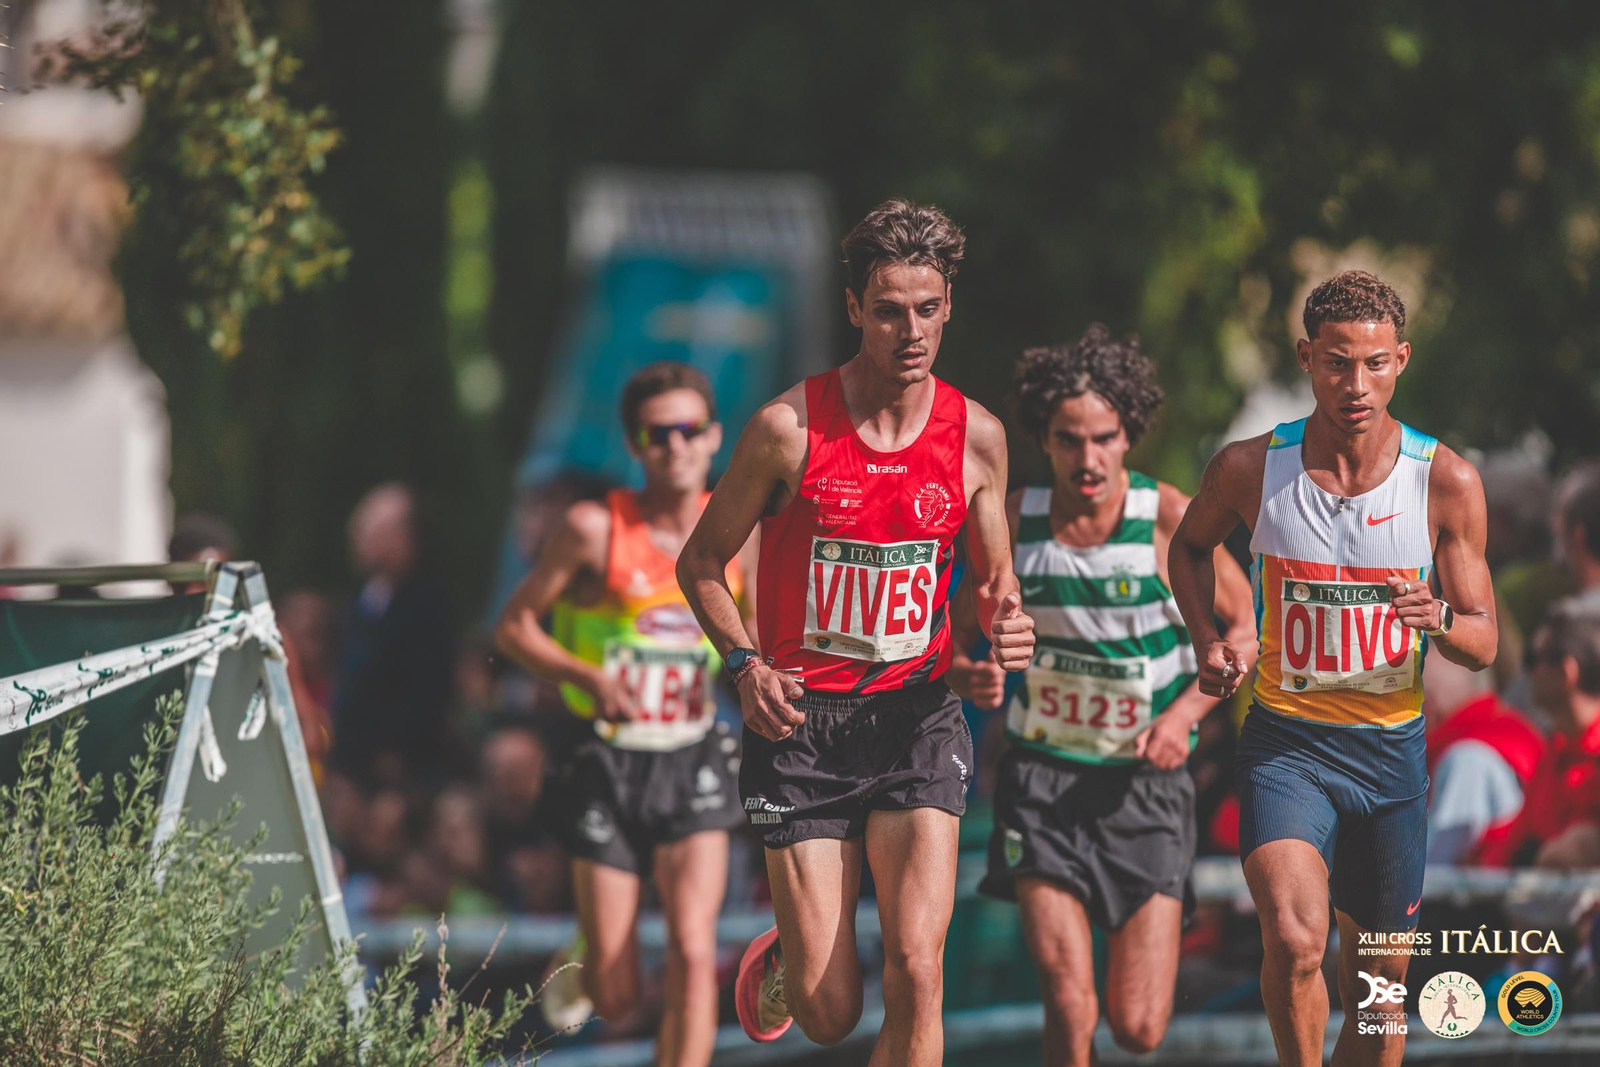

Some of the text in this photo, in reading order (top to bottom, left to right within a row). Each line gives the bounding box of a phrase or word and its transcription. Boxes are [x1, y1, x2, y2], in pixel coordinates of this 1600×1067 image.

[877, 464, 907, 474] rasán
[832, 478, 858, 487] Diputació
[925, 482, 939, 490] FENT
[850, 547, 907, 564] ITÁLICA
[813, 562, 932, 636] VIVES
[1319, 586, 1380, 602] ITÁLICA
[1285, 603, 1411, 672] OLIVO
[1039, 686, 1138, 730] 5123
[744, 797, 766, 810] FENT
[750, 812, 782, 825] MISLATA
